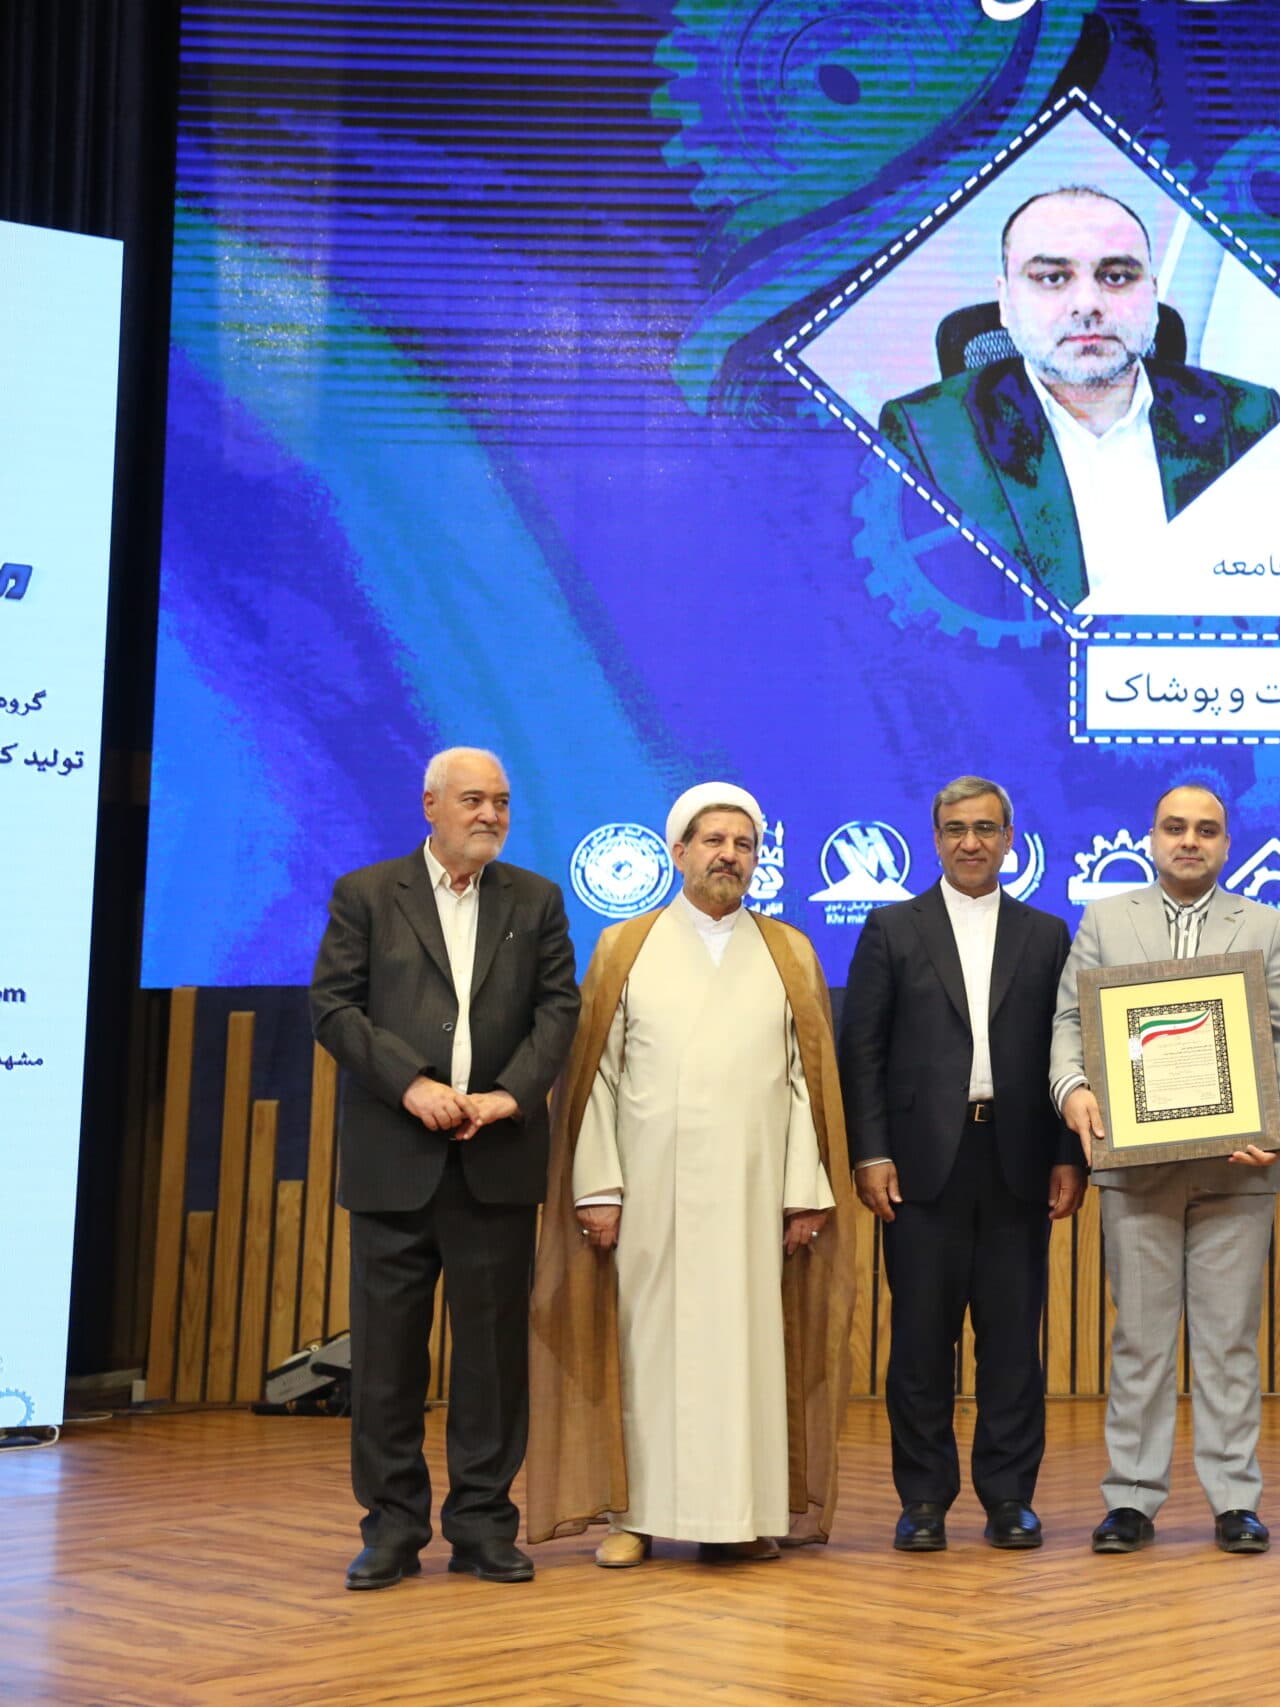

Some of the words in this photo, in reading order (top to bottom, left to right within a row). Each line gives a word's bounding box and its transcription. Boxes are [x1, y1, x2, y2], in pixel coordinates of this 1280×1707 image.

[1105, 673, 1222, 717] پوشاک
[1228, 687, 1245, 714] و
[23, 747, 84, 776] تولید
